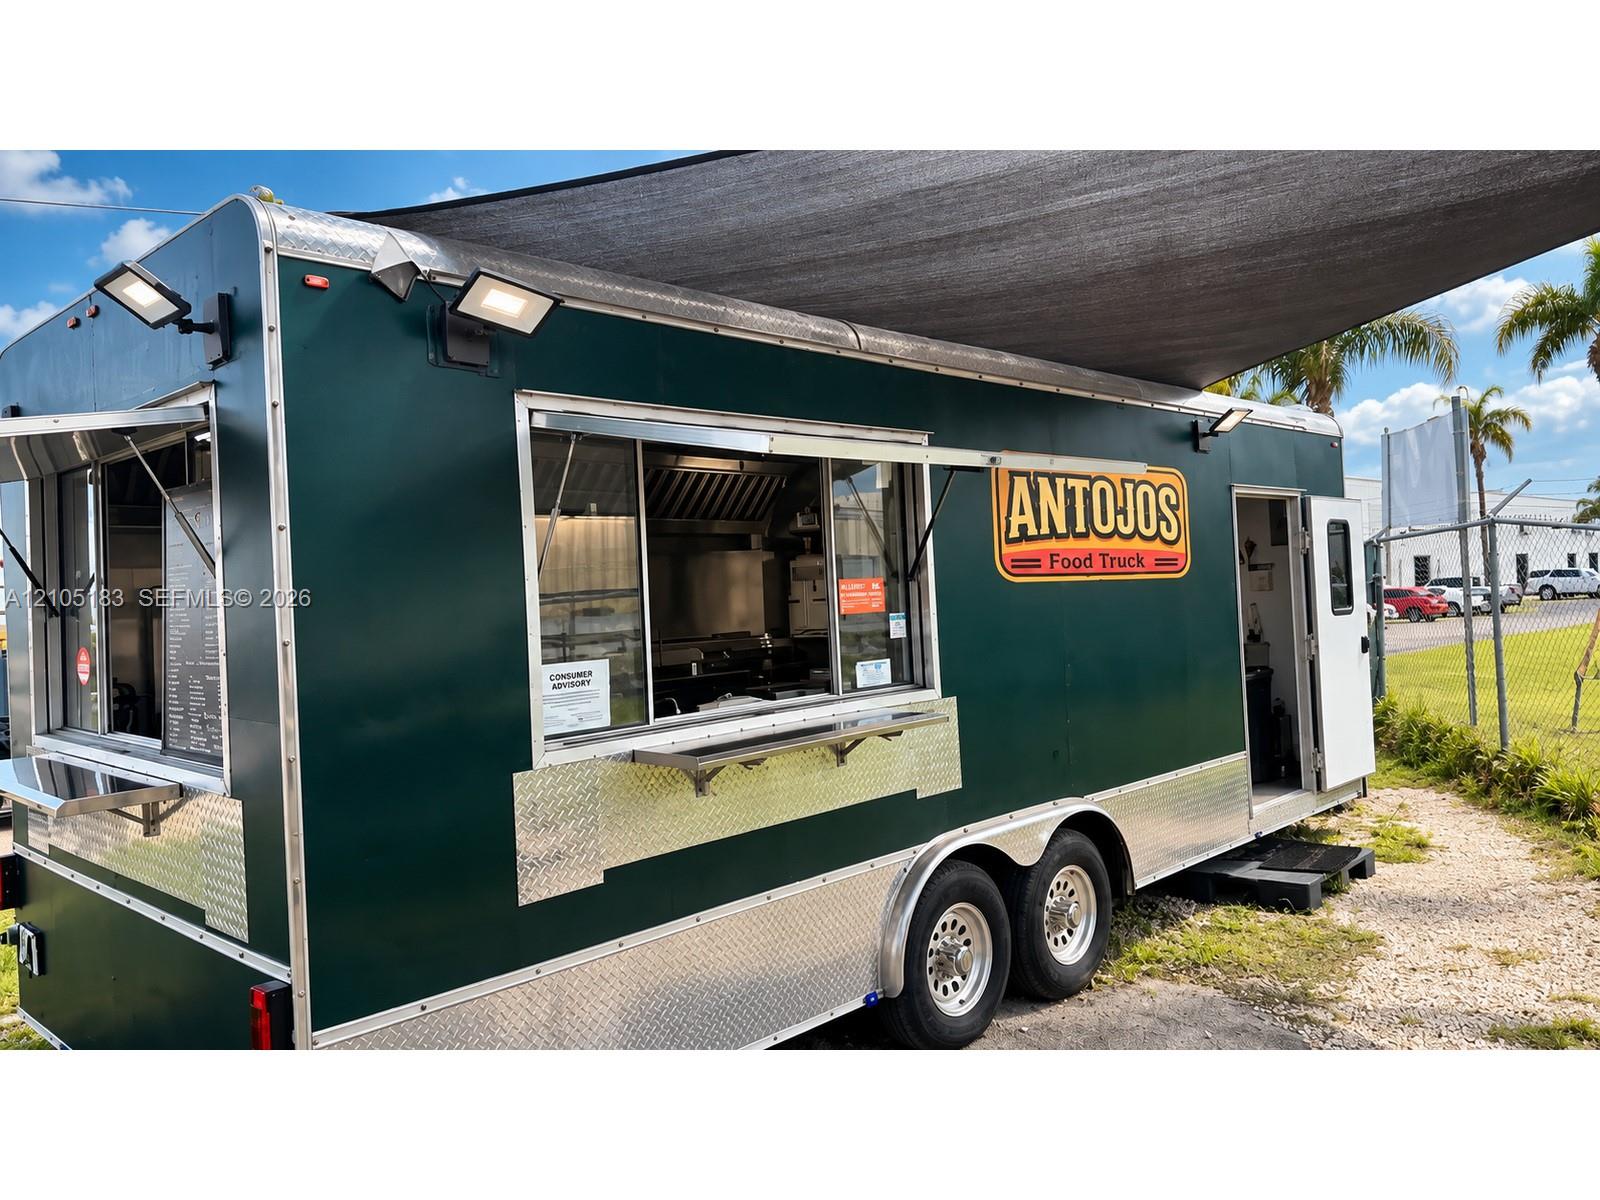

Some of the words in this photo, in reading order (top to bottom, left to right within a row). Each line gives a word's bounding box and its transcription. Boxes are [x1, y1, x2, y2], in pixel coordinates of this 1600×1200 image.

[1006, 473, 1181, 543] ANTOJOS
[1049, 553, 1093, 569] Food
[1099, 552, 1145, 569] Truck
[549, 670, 593, 682] CONSUMER
[551, 679, 592, 691] ADVISORY
